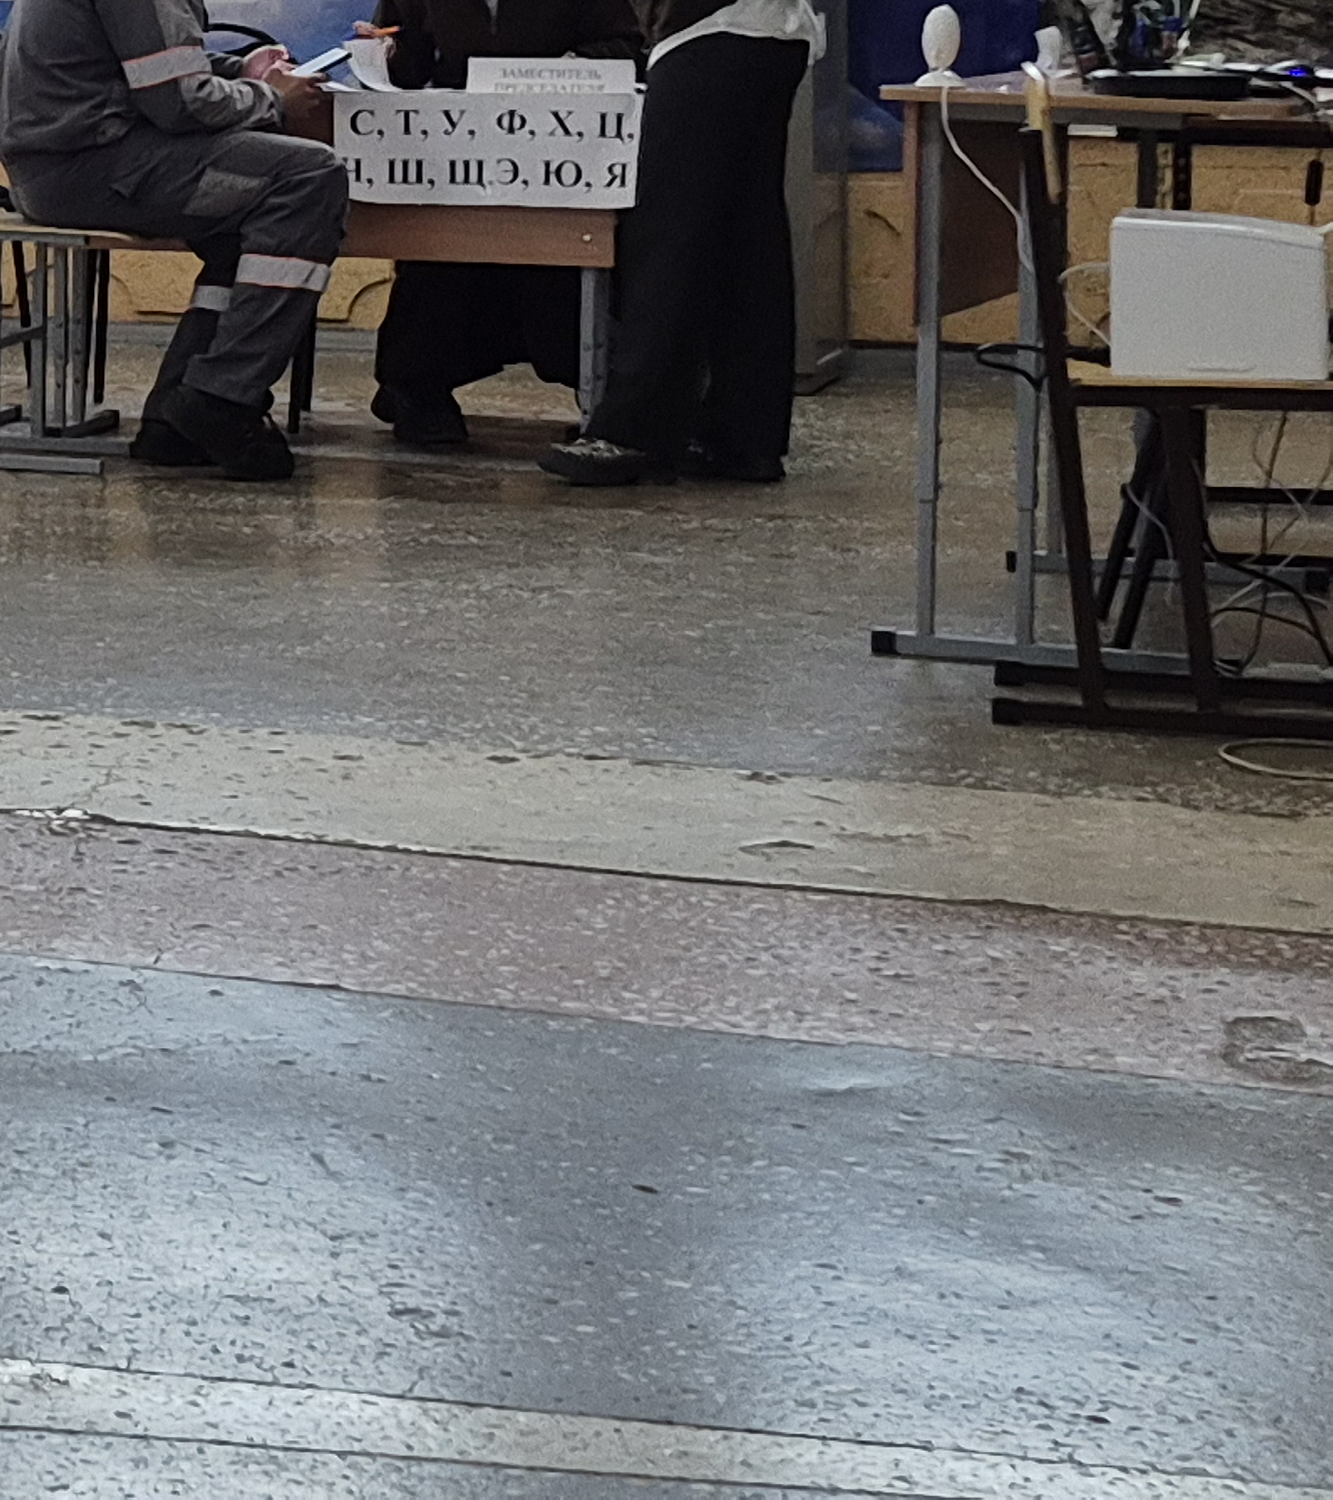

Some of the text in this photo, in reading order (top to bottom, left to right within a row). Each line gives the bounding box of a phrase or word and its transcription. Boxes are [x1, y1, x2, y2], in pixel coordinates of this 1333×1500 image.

[349, 109, 635, 144] С, Т, У, Ф, Х, Ц,
[388, 158, 436, 190] Ш,
[543, 159, 593, 193] Ю,
[603, 161, 628, 189] Я
